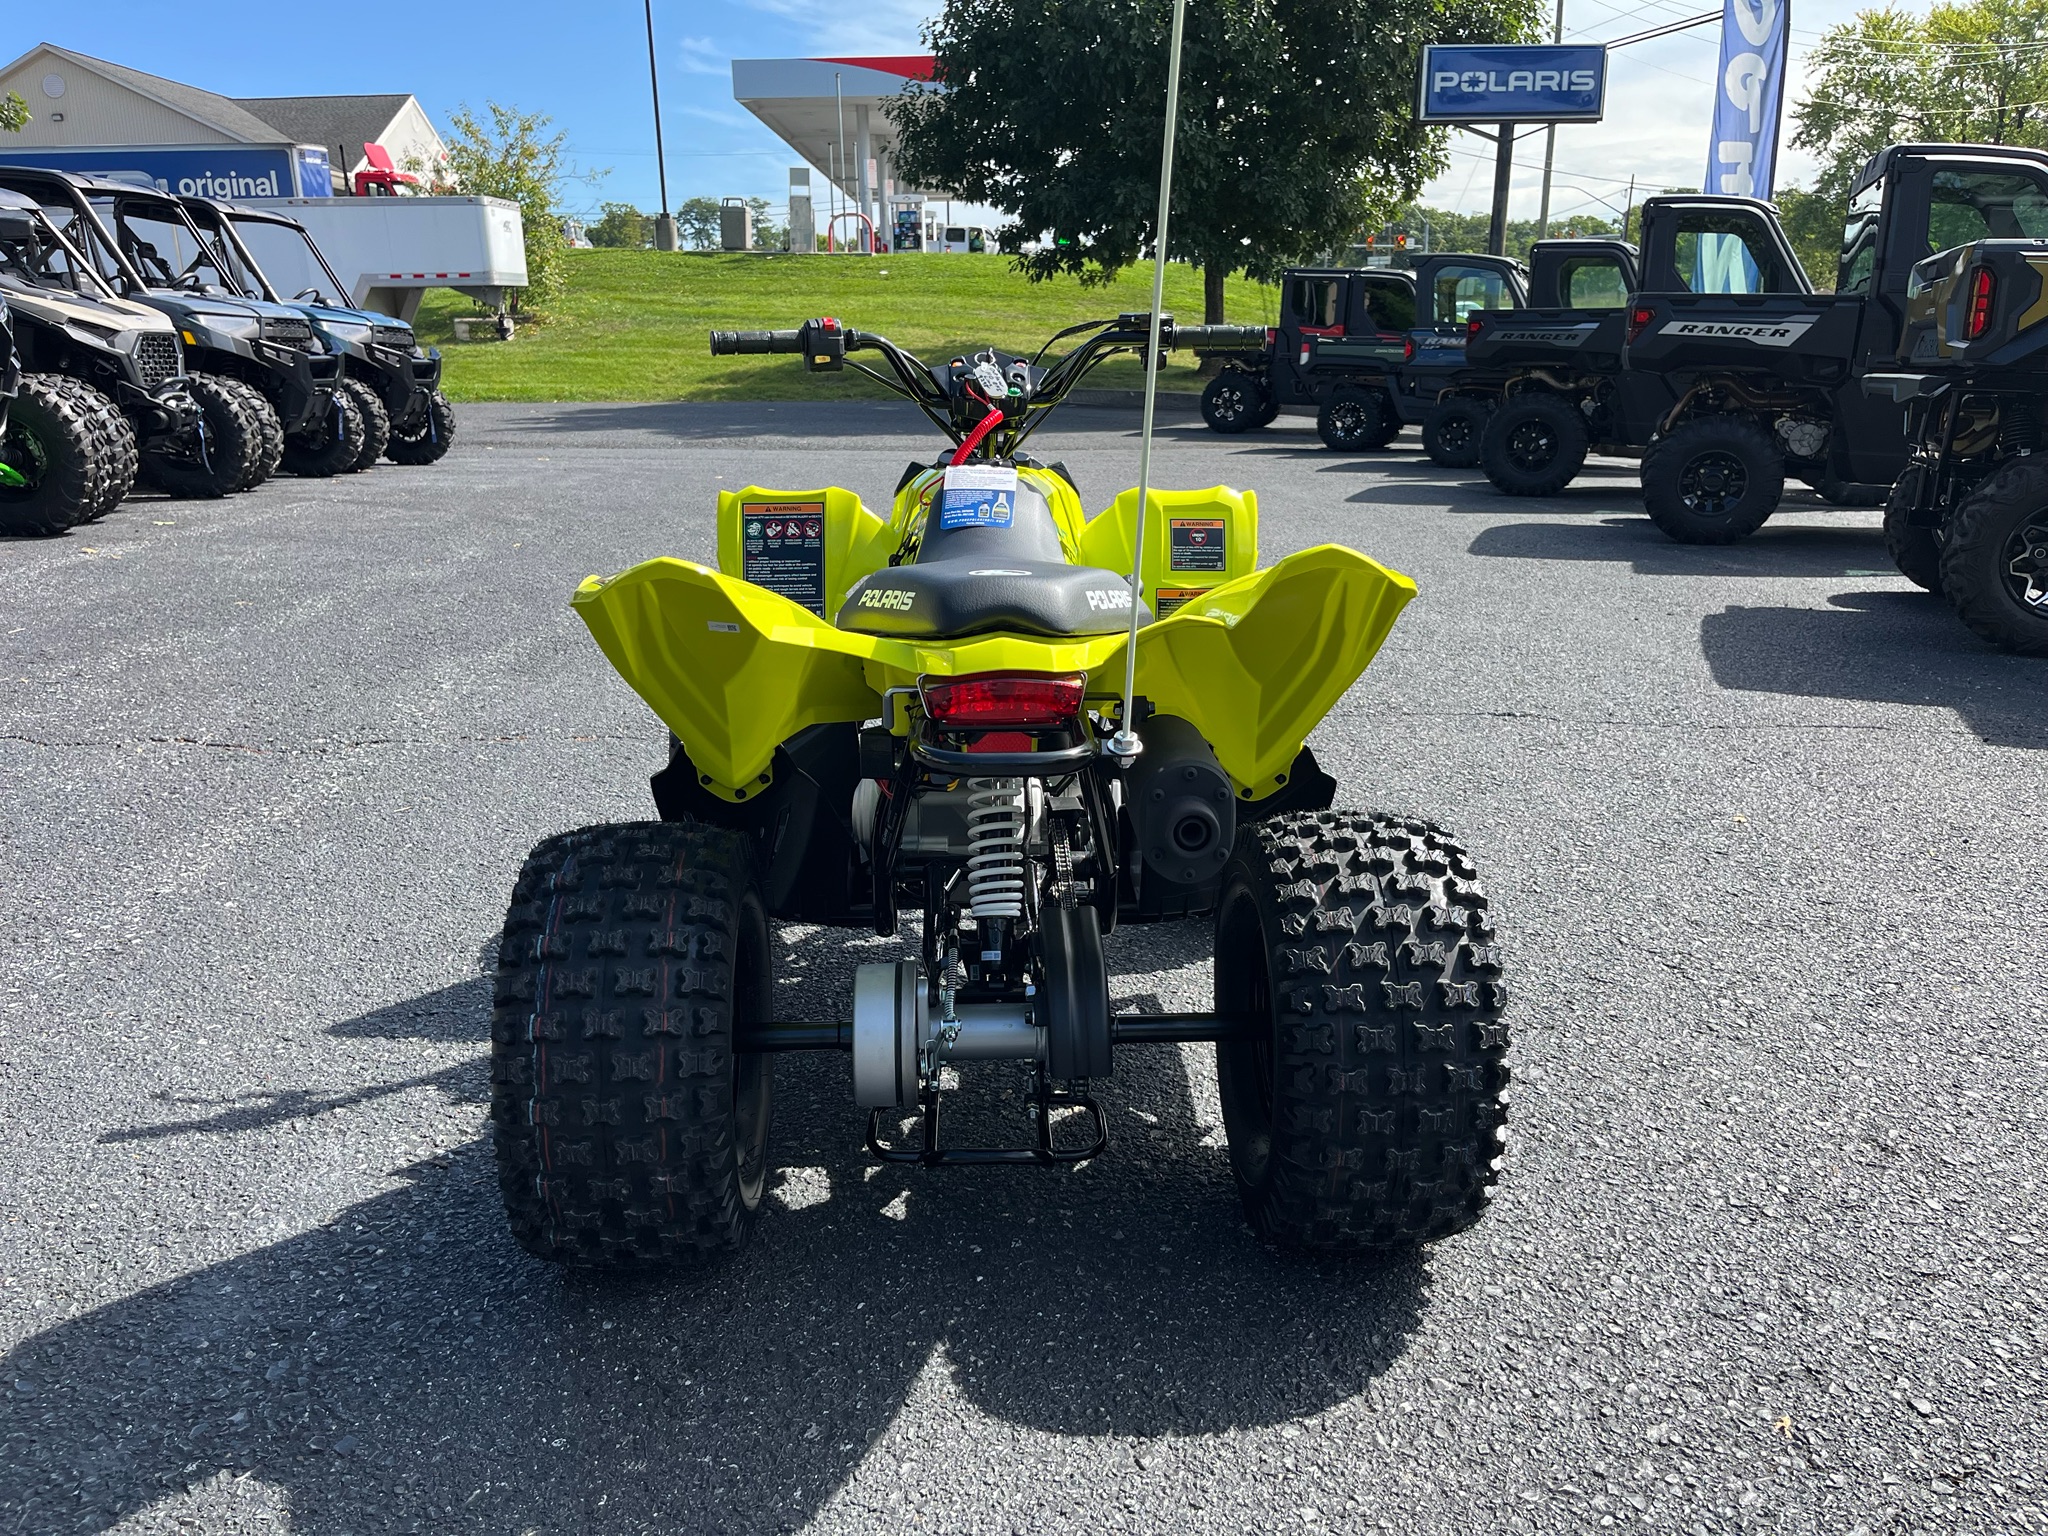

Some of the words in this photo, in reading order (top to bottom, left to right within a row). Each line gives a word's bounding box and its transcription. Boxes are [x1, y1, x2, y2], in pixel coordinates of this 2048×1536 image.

[1433, 70, 1596, 93] POLARIS
[178, 170, 279, 201] original
[1424, 337, 1467, 345] RAN
[1500, 332, 1580, 342] RANGER
[1677, 324, 1791, 338] RANGER
[858, 589, 916, 611] POLARIS
[1085, 590, 1133, 610] POLARIS
